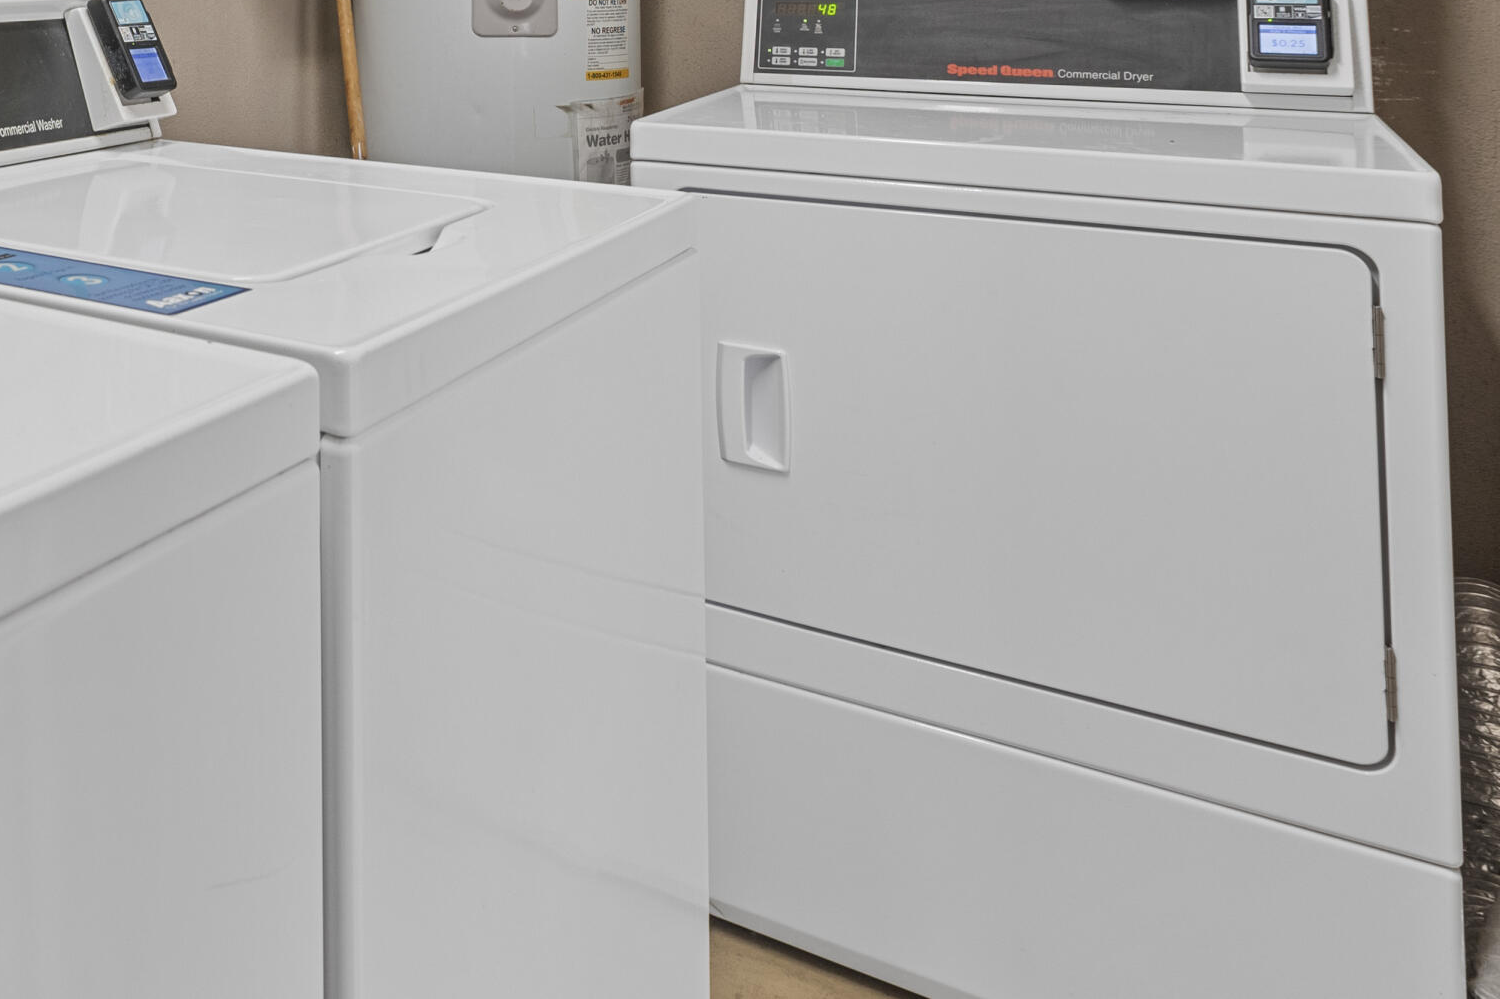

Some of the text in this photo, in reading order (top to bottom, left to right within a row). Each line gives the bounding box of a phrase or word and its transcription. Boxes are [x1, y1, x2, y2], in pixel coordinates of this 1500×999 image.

[818, 3, 837, 16] 48
[602, 26, 625, 34] REGRESE
[1272, 39, 1305, 47] $0.25
[947, 63, 1154, 83] Speed Queen Commercial Dryer
[37, 118, 63, 131] Washer
[587, 133, 621, 147] Water
[70, 275, 103, 285] 3
[145, 285, 216, 309] Aaxon
